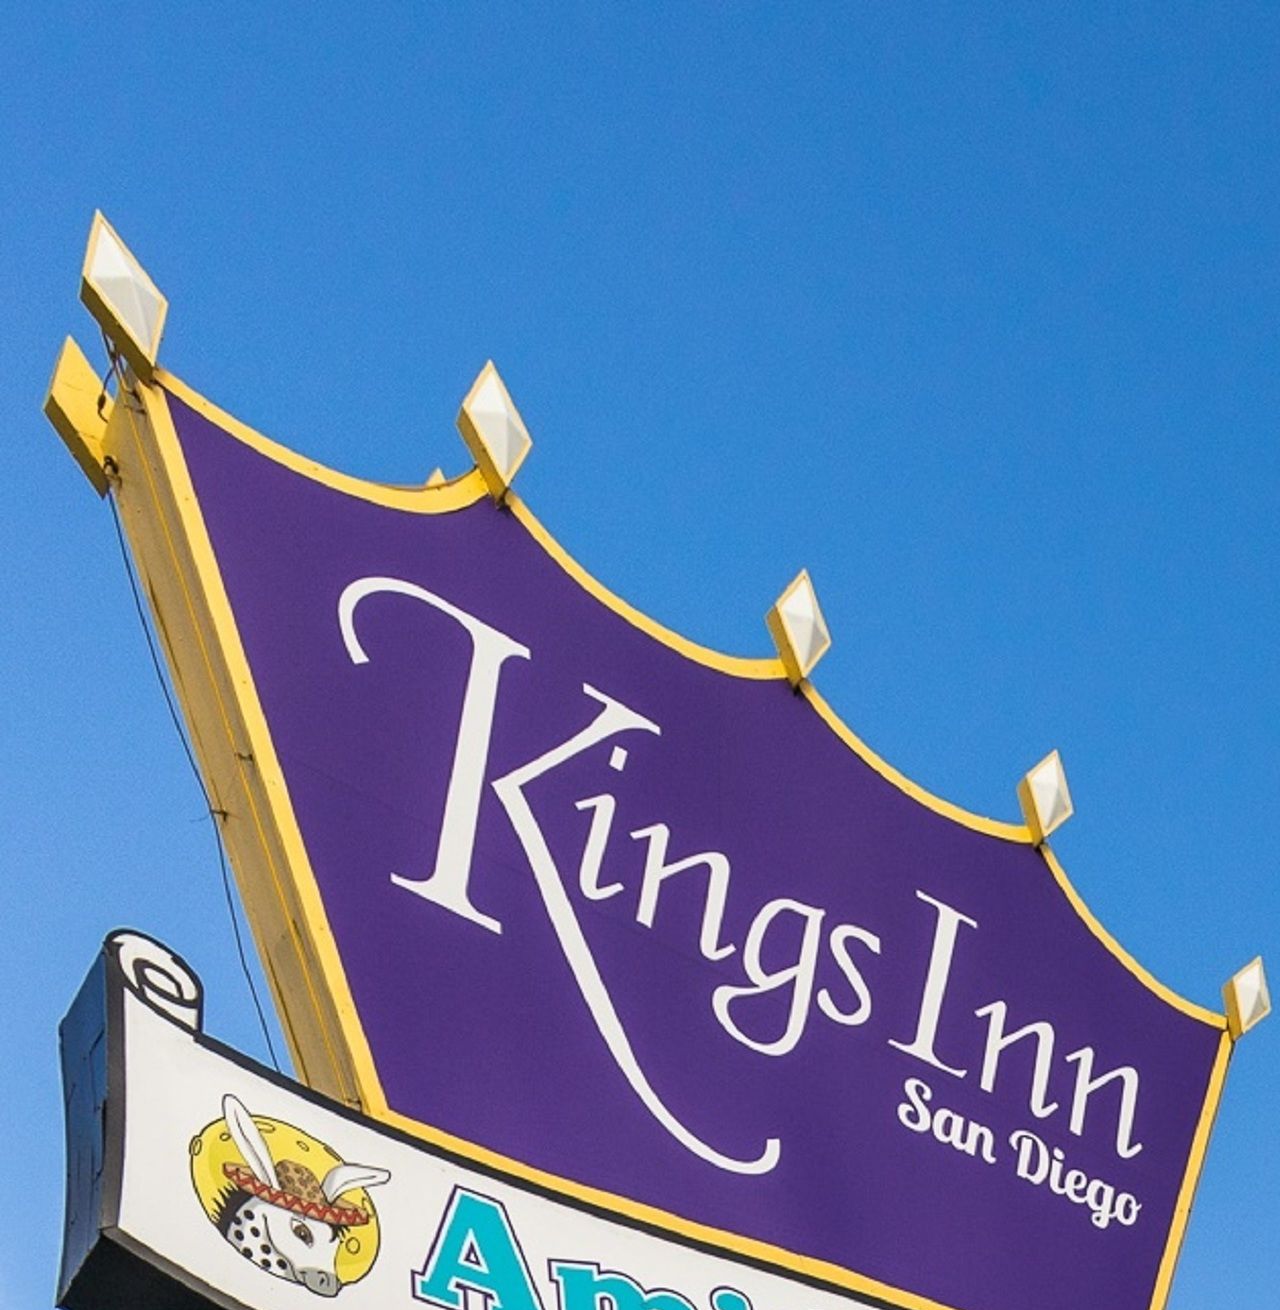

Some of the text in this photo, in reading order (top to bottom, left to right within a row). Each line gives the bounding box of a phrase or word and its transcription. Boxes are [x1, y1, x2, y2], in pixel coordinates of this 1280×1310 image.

[339, 578, 1141, 1174] Kings Inn
[898, 1079, 1141, 1228] San Diego
